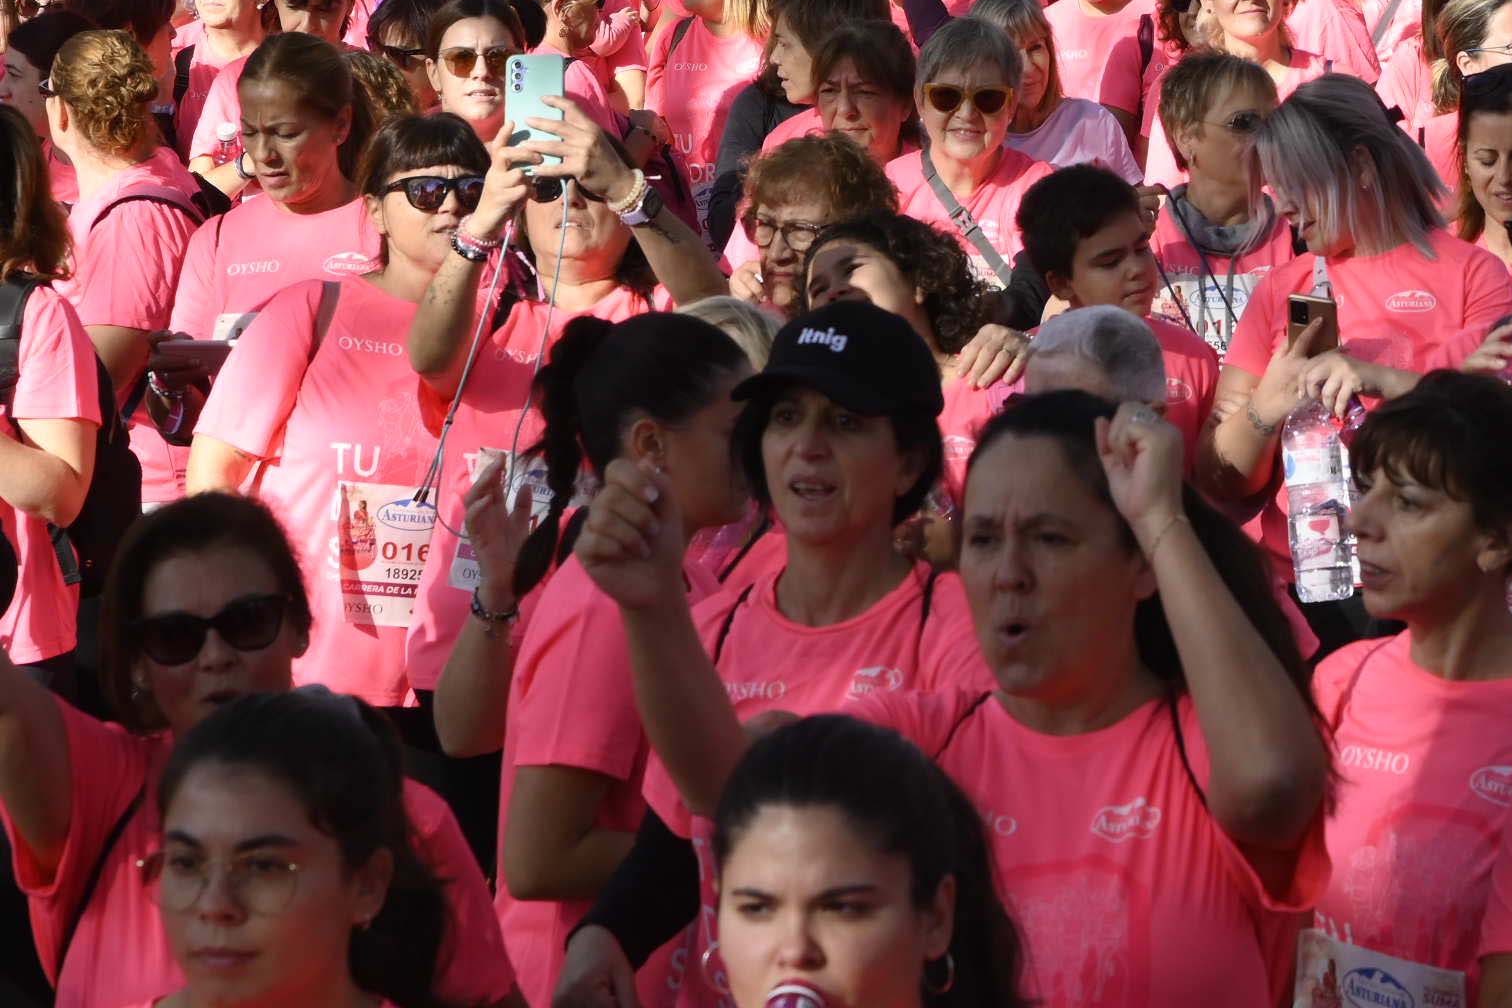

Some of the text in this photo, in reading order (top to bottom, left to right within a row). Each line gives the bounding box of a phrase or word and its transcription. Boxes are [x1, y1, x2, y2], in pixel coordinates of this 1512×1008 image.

[226, 260, 280, 277] OYSHO
[338, 336, 403, 358] OYSHO
[330, 442, 381, 478] TU
[381, 541, 430, 562] 016
[387, 586, 400, 595] DE
[1339, 745, 1410, 775] OYSHO
